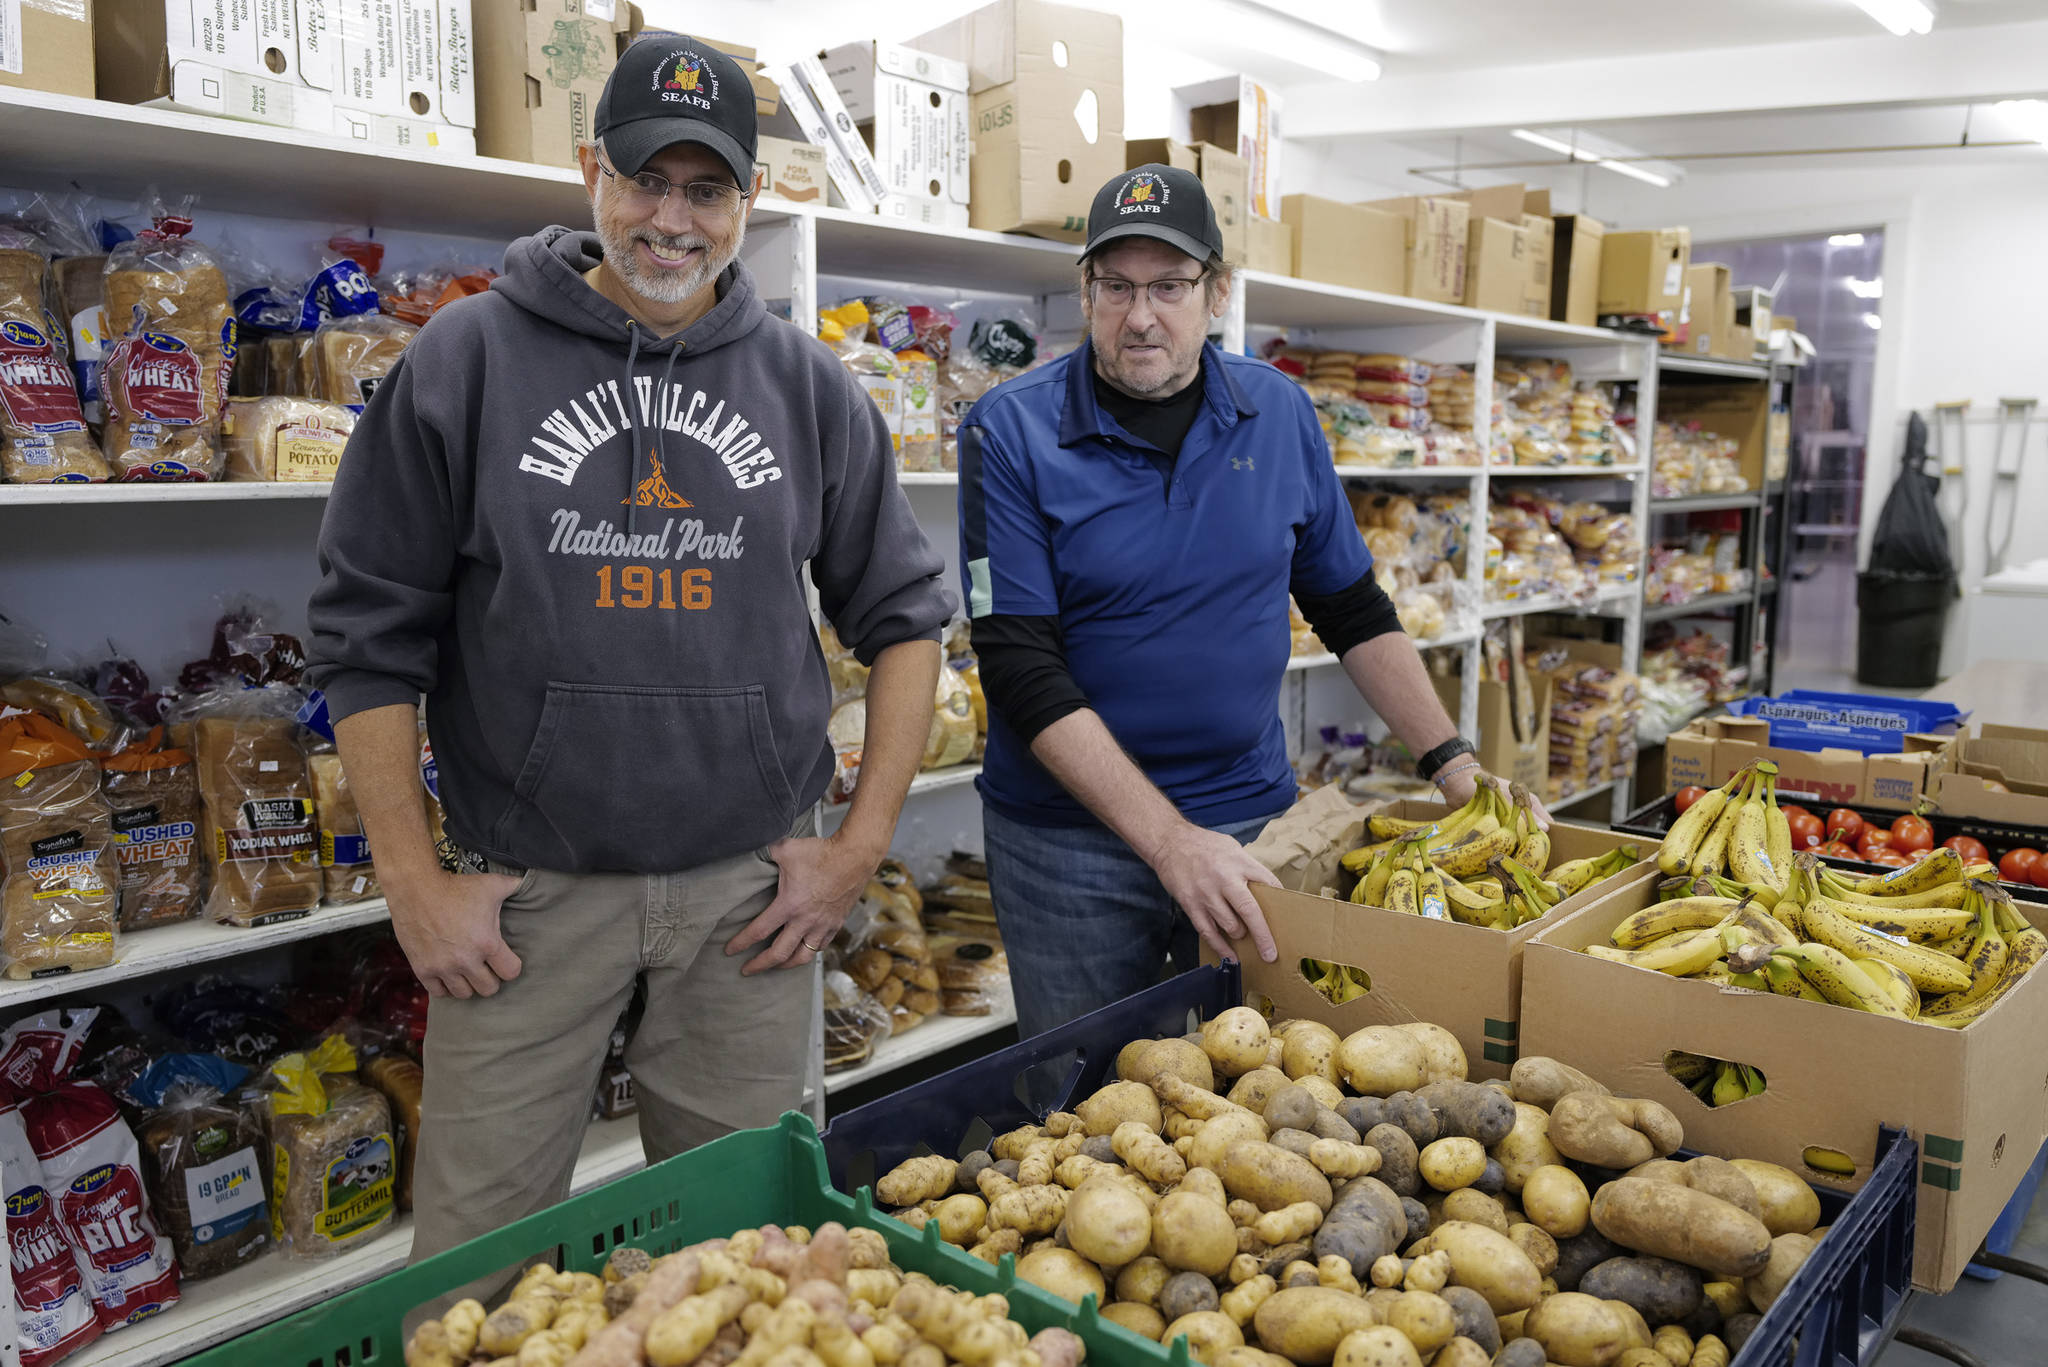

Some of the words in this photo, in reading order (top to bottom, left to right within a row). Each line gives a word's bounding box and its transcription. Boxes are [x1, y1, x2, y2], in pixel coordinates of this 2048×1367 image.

[203, 17, 213, 52] #02239
[216, 32, 226, 44] lb
[262, 18, 270, 38] Fresh
[282, 23, 291, 40] NET
[307, 11, 319, 53] Better
[377, 15, 386, 39] Ready
[413, 9, 421, 46] California
[425, 25, 432, 35] 10
[448, 7, 461, 53] Burger
[217, 43, 226, 54] 10
[386, 29, 394, 68] Substitute
[406, 42, 414, 59] Leaf
[425, 36, 433, 65] WEIGHT
[364, 48, 374, 79] Singles
[378, 47, 386, 78] Washed
[449, 56, 461, 94] Better
[651, 57, 670, 91] Southeast
[670, 49, 699, 60] Alaska
[699, 57, 717, 79] Food
[710, 78, 720, 101] Bank
[661, 91, 711, 110] SEAFB
[1153, 174, 1169, 190] Food
[1160, 188, 1171, 205] Bank
[1119, 204, 1161, 215] SEAFB
[6, 323, 43, 345] Franz
[128, 368, 194, 393] WHEAT
[288, 451, 338, 466] POTATO
[547, 507, 675, 560] National
[675, 514, 745, 561] Park
[595, 564, 713, 611] 1916
[1758, 703, 1831, 722] Asparagus
[1838, 709, 1908, 731] Asperges
[252, 801, 295, 821] ALASKA
[37, 835, 76, 851] Signature
[231, 836, 277, 851] KODIAK
[75, 1167, 113, 1192] Franz
[198, 1181, 212, 1198] 19
[7, 1188, 43, 1216] Franz
[79, 1205, 145, 1254] BIG
